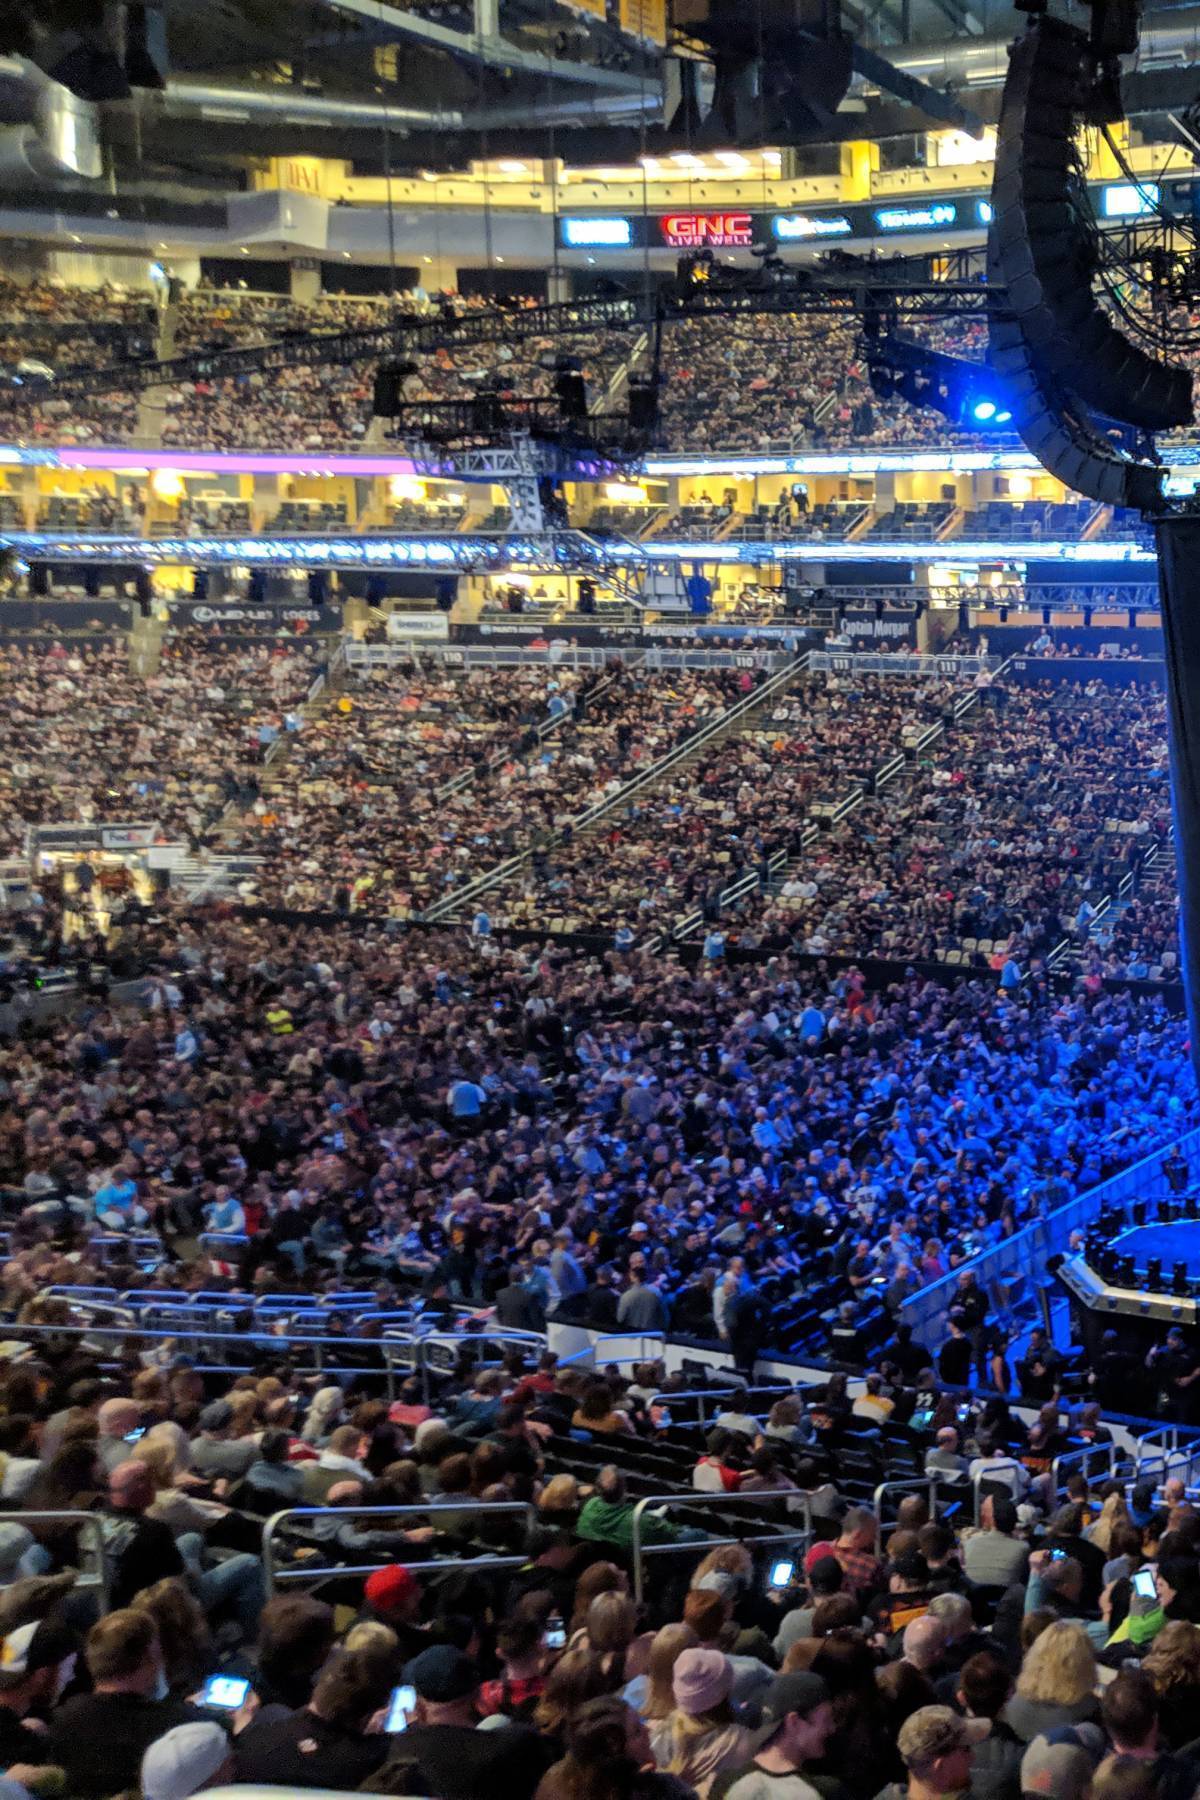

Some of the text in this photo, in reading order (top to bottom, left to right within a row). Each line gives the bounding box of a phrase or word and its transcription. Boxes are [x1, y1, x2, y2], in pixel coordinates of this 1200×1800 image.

[668, 235, 752, 246] LIVE WELL
[841, 618, 910, 639] Captain Morgan
[736, 655, 754, 668] 110
